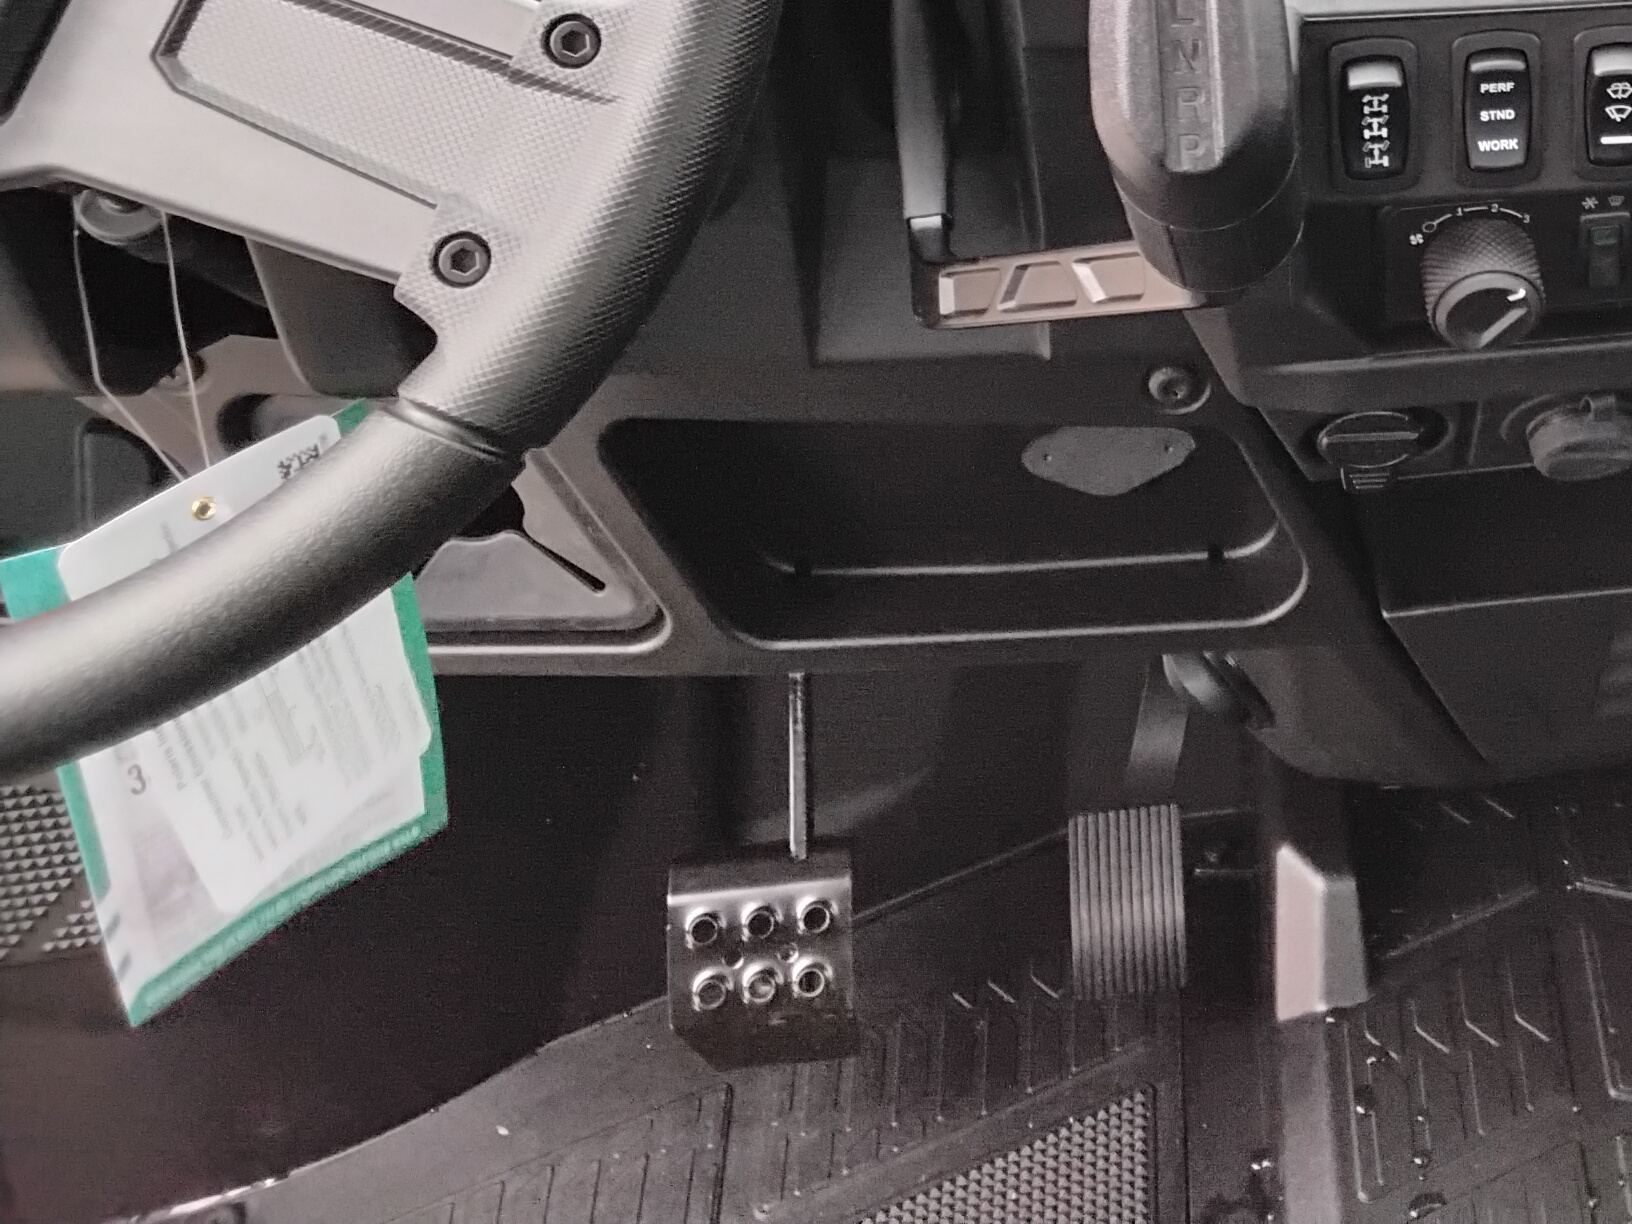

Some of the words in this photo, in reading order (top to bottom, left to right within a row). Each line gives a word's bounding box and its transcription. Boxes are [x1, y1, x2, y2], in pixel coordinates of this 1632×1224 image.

[1172, 39, 1202, 74] N
[1480, 82, 1515, 93] PERF
[1177, 87, 1206, 123] R
[1480, 109, 1515, 122] STND
[1478, 138, 1518, 152] WORK
[1178, 134, 1205, 171] P
[1456, 207, 1463, 216] 1
